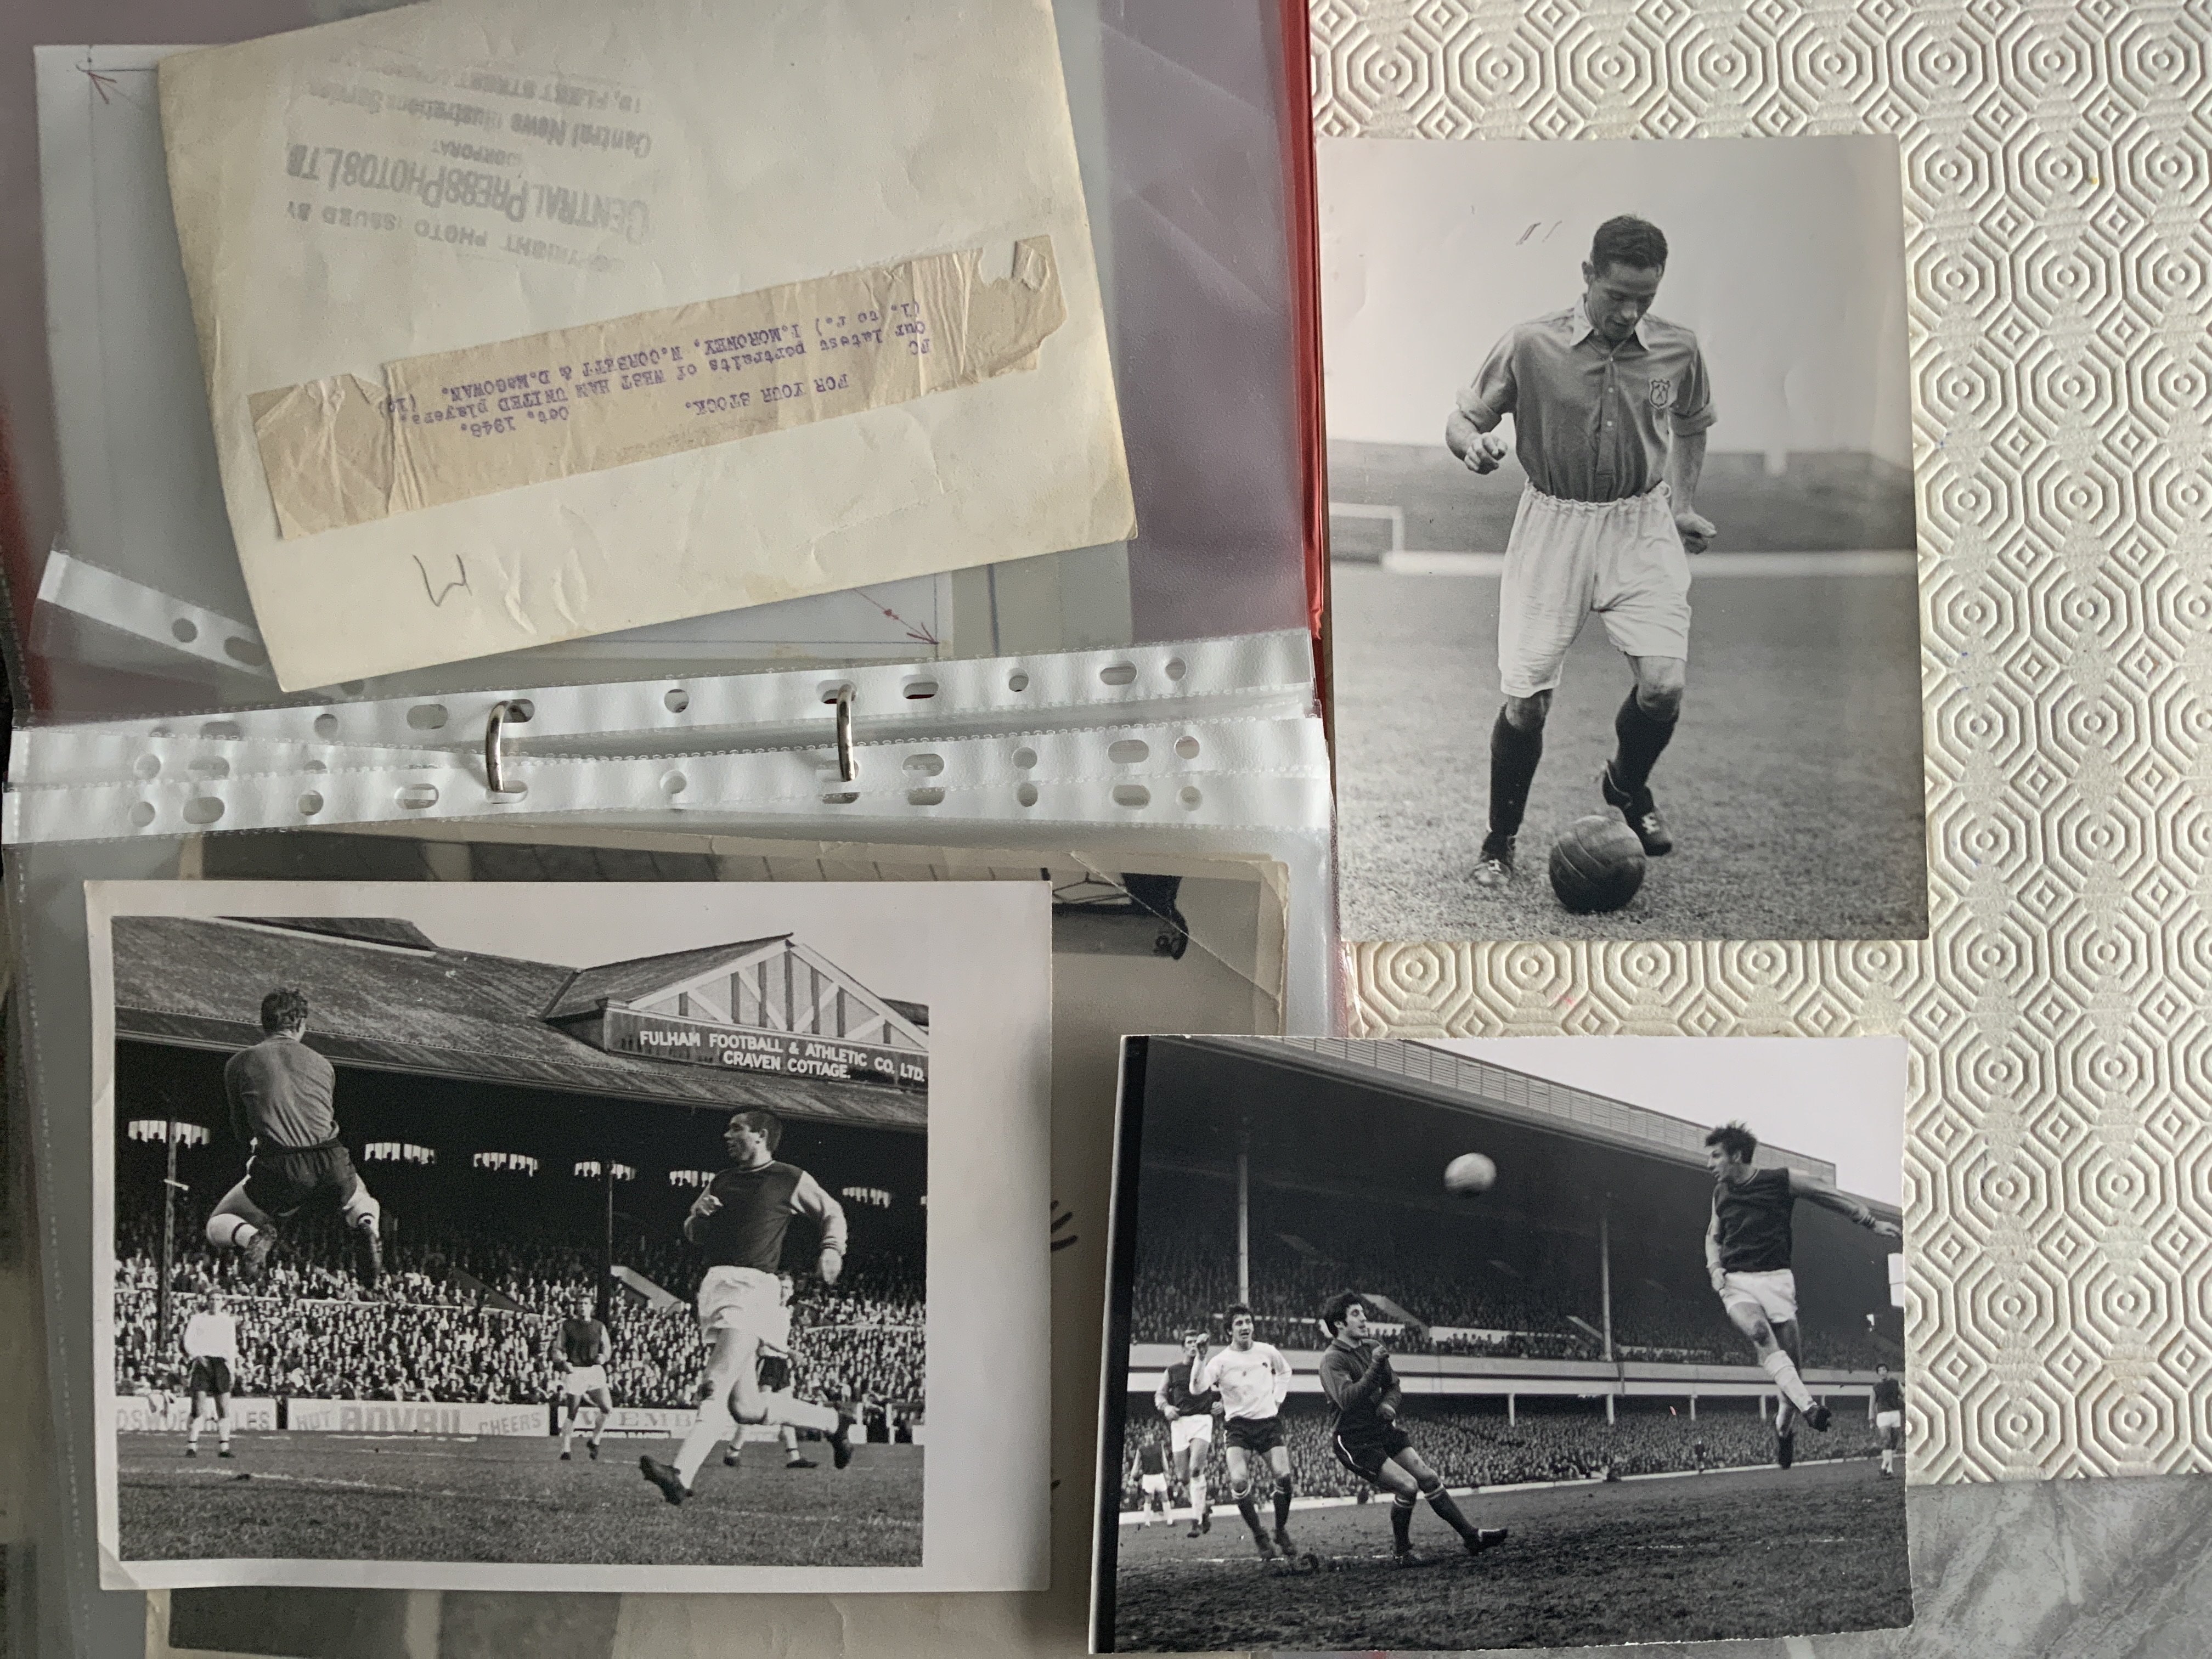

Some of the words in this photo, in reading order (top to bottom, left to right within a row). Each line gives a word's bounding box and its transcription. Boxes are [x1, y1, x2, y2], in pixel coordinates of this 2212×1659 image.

[532, 185, 650, 245] CENTRAL
[415, 219, 489, 247] PHOTO
[857, 310, 878, 324] to
[894, 320, 926, 337] Our
[819, 329, 883, 351] latest
[708, 342, 806, 373] portraits
[558, 365, 572, 381] &
[620, 369, 666, 391] WEST
[676, 364, 697, 381] of
[813, 374, 849, 393] FOR
[497, 387, 569, 412] UNITED
[575, 379, 610, 398] HAM
[760, 383, 804, 403] YOUR
[686, 392, 751, 416] STOCK.
[527, 406, 569, 425] Oct.
[639, 1031, 701, 1047] FULHAM
[709, 1033, 783, 1053] FOOTBALL
[788, 1042, 800, 1056] &
[805, 1043, 867, 1067] ATHLETIC
[873, 1057, 895, 1075] CO.
[900, 1064, 926, 1082] LTD.
[723, 1051, 781, 1071] CRAVEN
[787, 1059, 851, 1079] COTTAGE.
[478, 1412, 542, 1435] CHEERS
